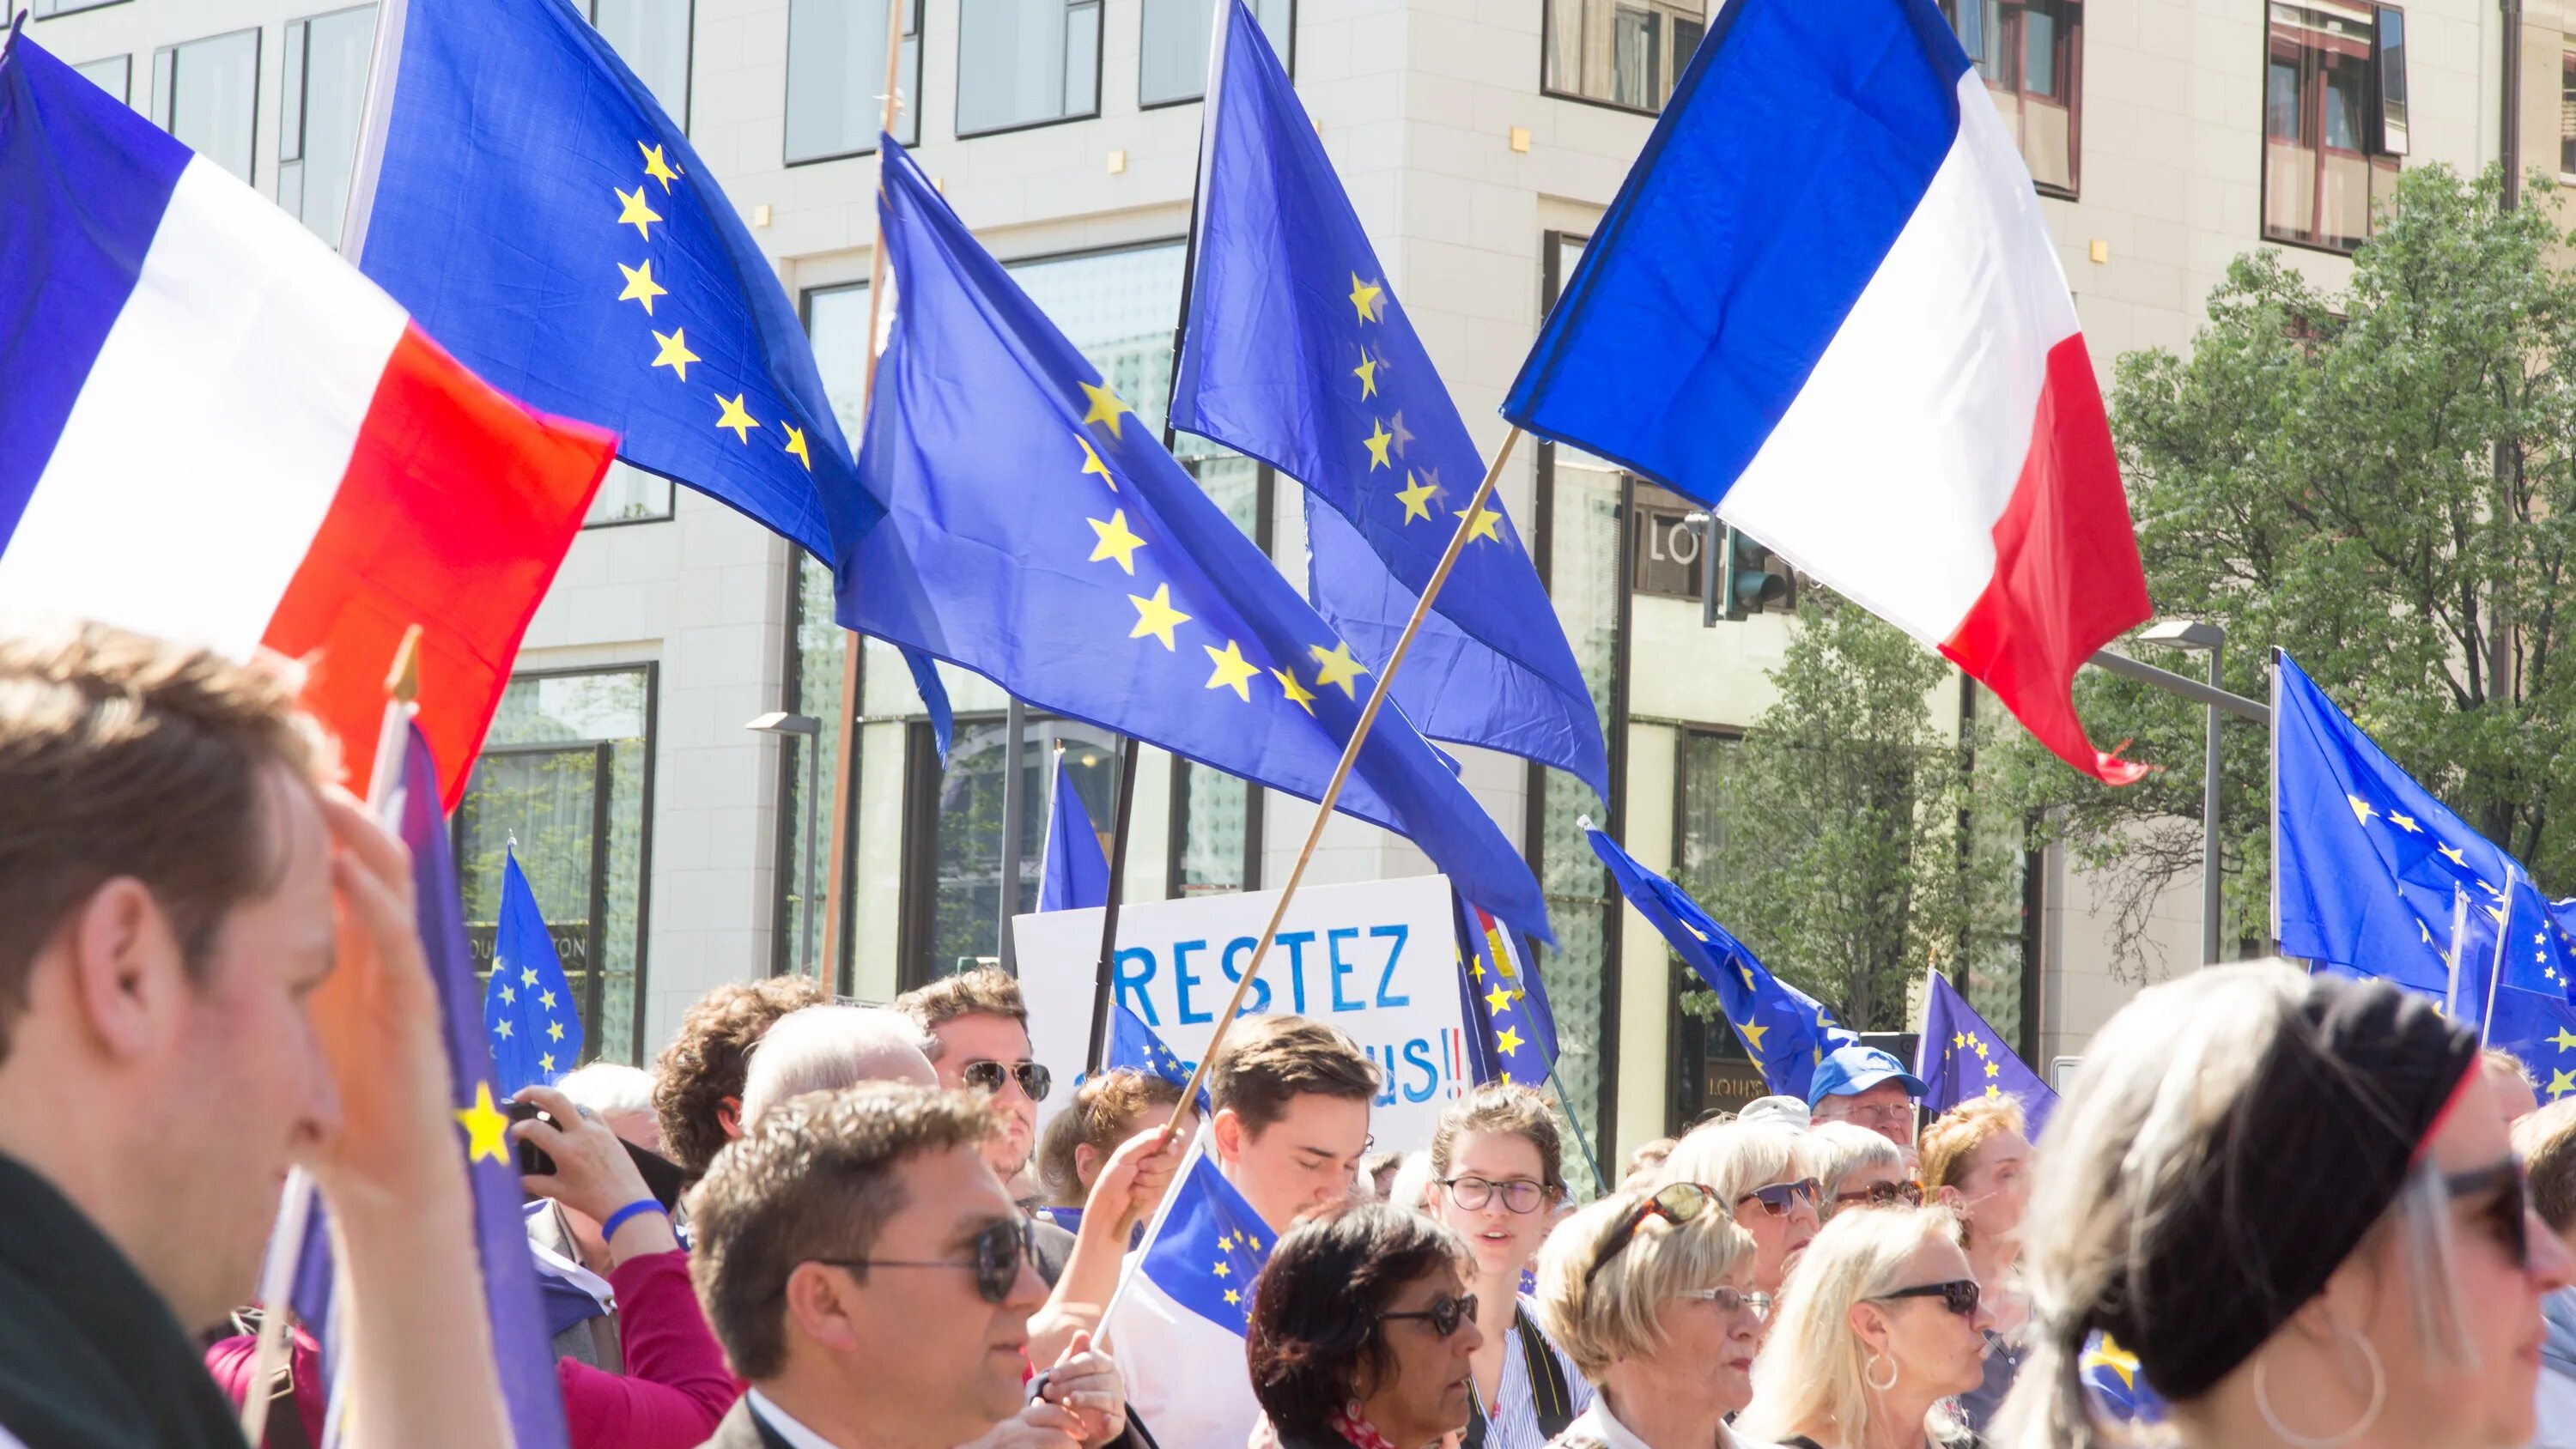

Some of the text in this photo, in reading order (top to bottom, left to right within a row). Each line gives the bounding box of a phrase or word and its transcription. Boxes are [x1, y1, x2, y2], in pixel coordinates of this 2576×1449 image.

[1650, 518, 1726, 567] LO
[551, 937, 586, 958] TON
[1113, 924, 1409, 1027] RESTEZ
